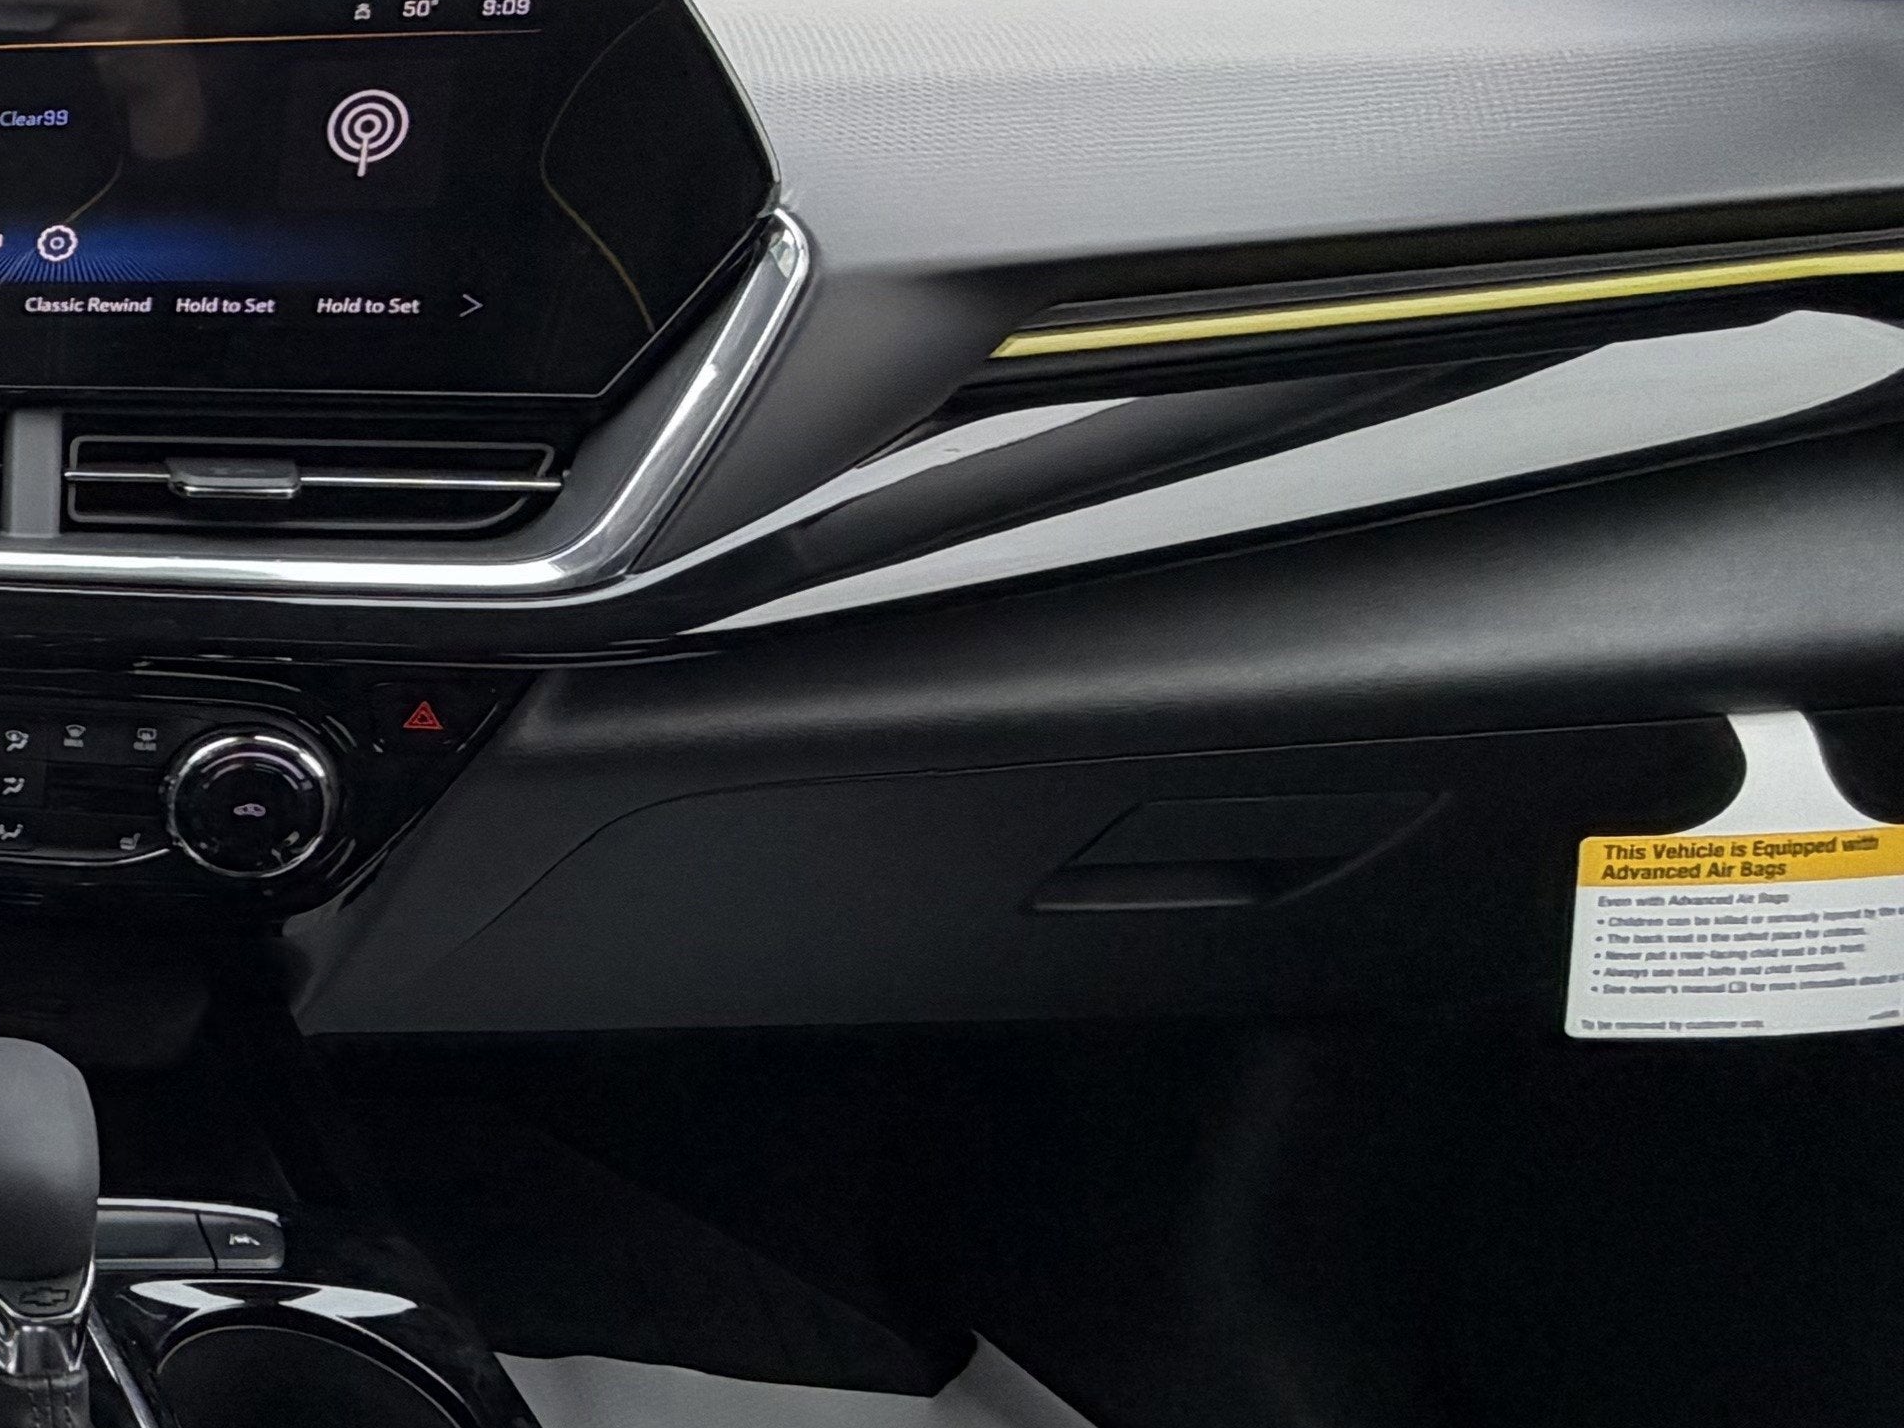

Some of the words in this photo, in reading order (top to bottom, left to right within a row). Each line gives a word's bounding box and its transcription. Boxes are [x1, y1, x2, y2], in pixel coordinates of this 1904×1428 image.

[0, 109, 70, 127] Clear99
[25, 296, 84, 312] Classic
[87, 296, 152, 312] Rewind
[175, 297, 219, 313] Hold
[222, 299, 241, 313] to
[244, 298, 276, 313] Set
[316, 297, 361, 314] Hold
[365, 299, 385, 314] to
[388, 298, 421, 314] Set
[1604, 844, 1646, 860] This
[1653, 842, 1724, 859] Vehicle
[1730, 841, 1747, 857] is
[1752, 837, 1837, 859] Equipped
[1601, 862, 1701, 880] Advanced
[1706, 861, 1735, 878] Air
[1740, 861, 1787, 880] Bags
